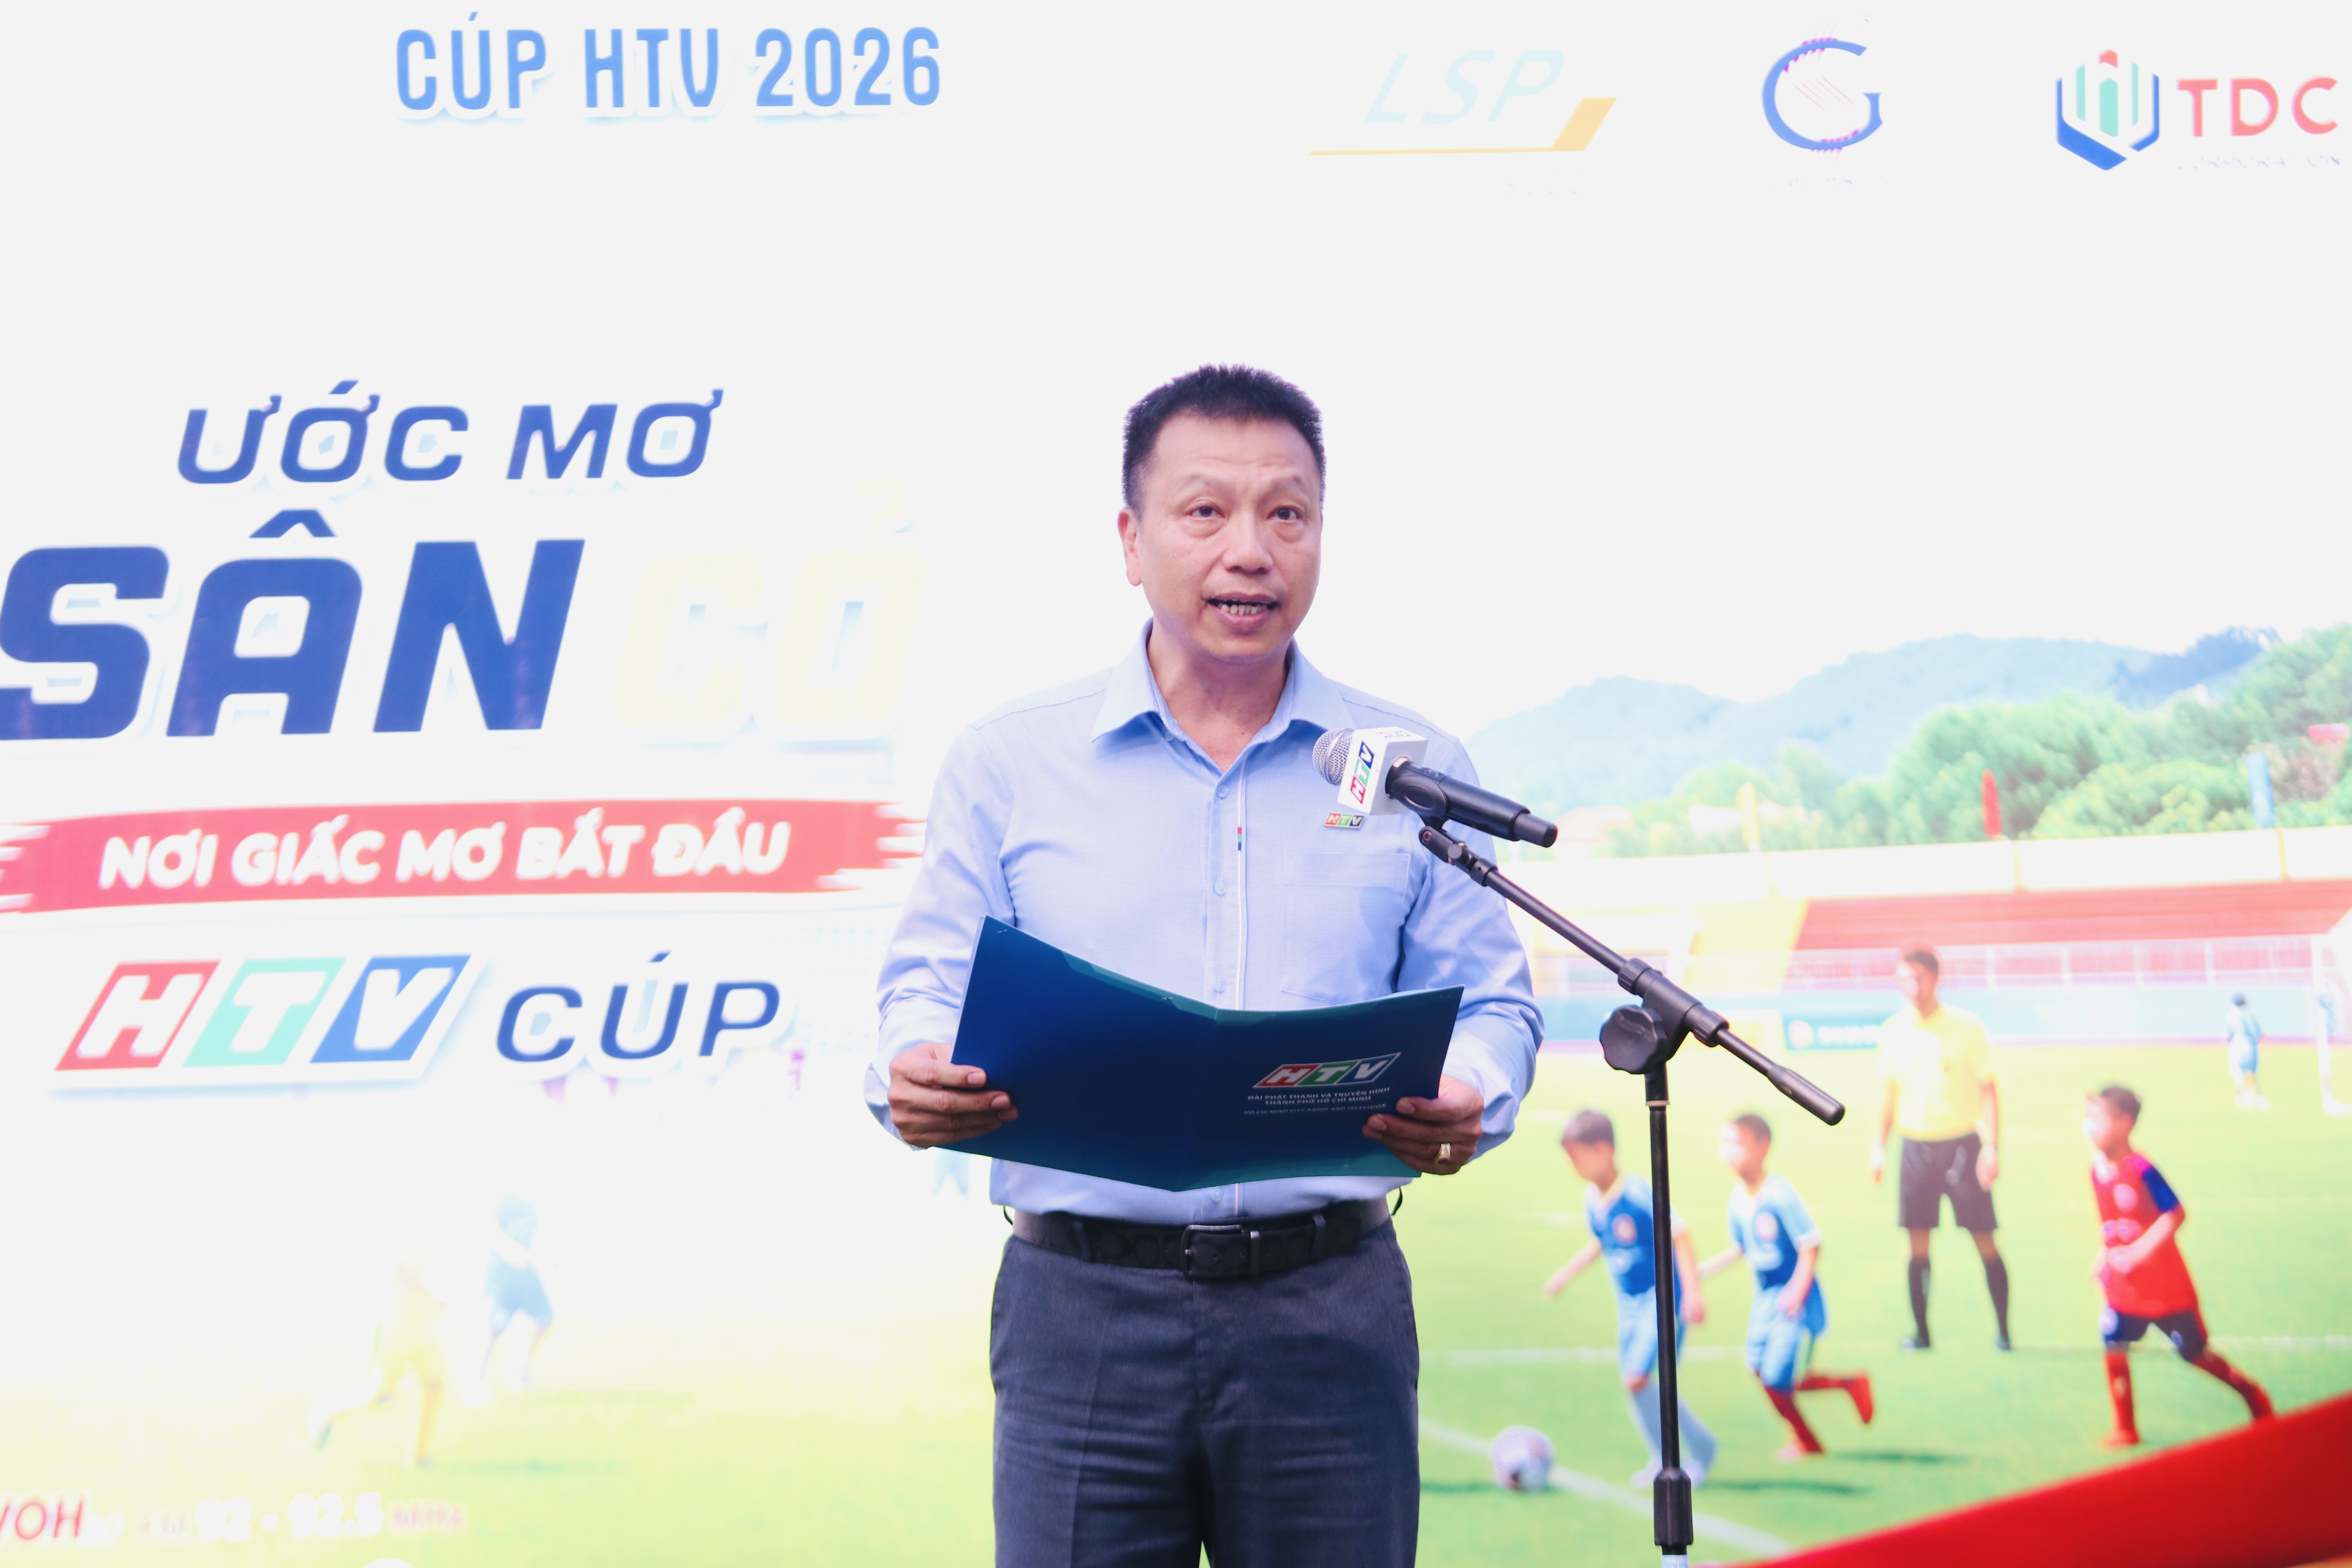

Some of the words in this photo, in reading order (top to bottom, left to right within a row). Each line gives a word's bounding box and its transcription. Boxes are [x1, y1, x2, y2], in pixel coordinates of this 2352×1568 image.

[397, 12, 546, 110] CÚP
[584, 28, 719, 108] HTV
[755, 26, 940, 107] 2026
[1364, 49, 1566, 125] LSP
[2176, 76, 2339, 137] TDC
[178, 380, 469, 484] ƯỚC
[506, 388, 724, 479] MƠ
[0, 509, 585, 740] SÂN
[611, 476, 929, 728] CỎ
[1350, 740, 1374, 804] HTV
[98, 828, 219, 889] NƠI
[231, 813, 385, 887] GIẤC
[395, 821, 506, 882] MƠ
[1326, 814, 1363, 827] HTV
[74, 965, 457, 1058] HTV
[495, 951, 781, 1063] CÚP
[1264, 1058, 1392, 1084] HTV
